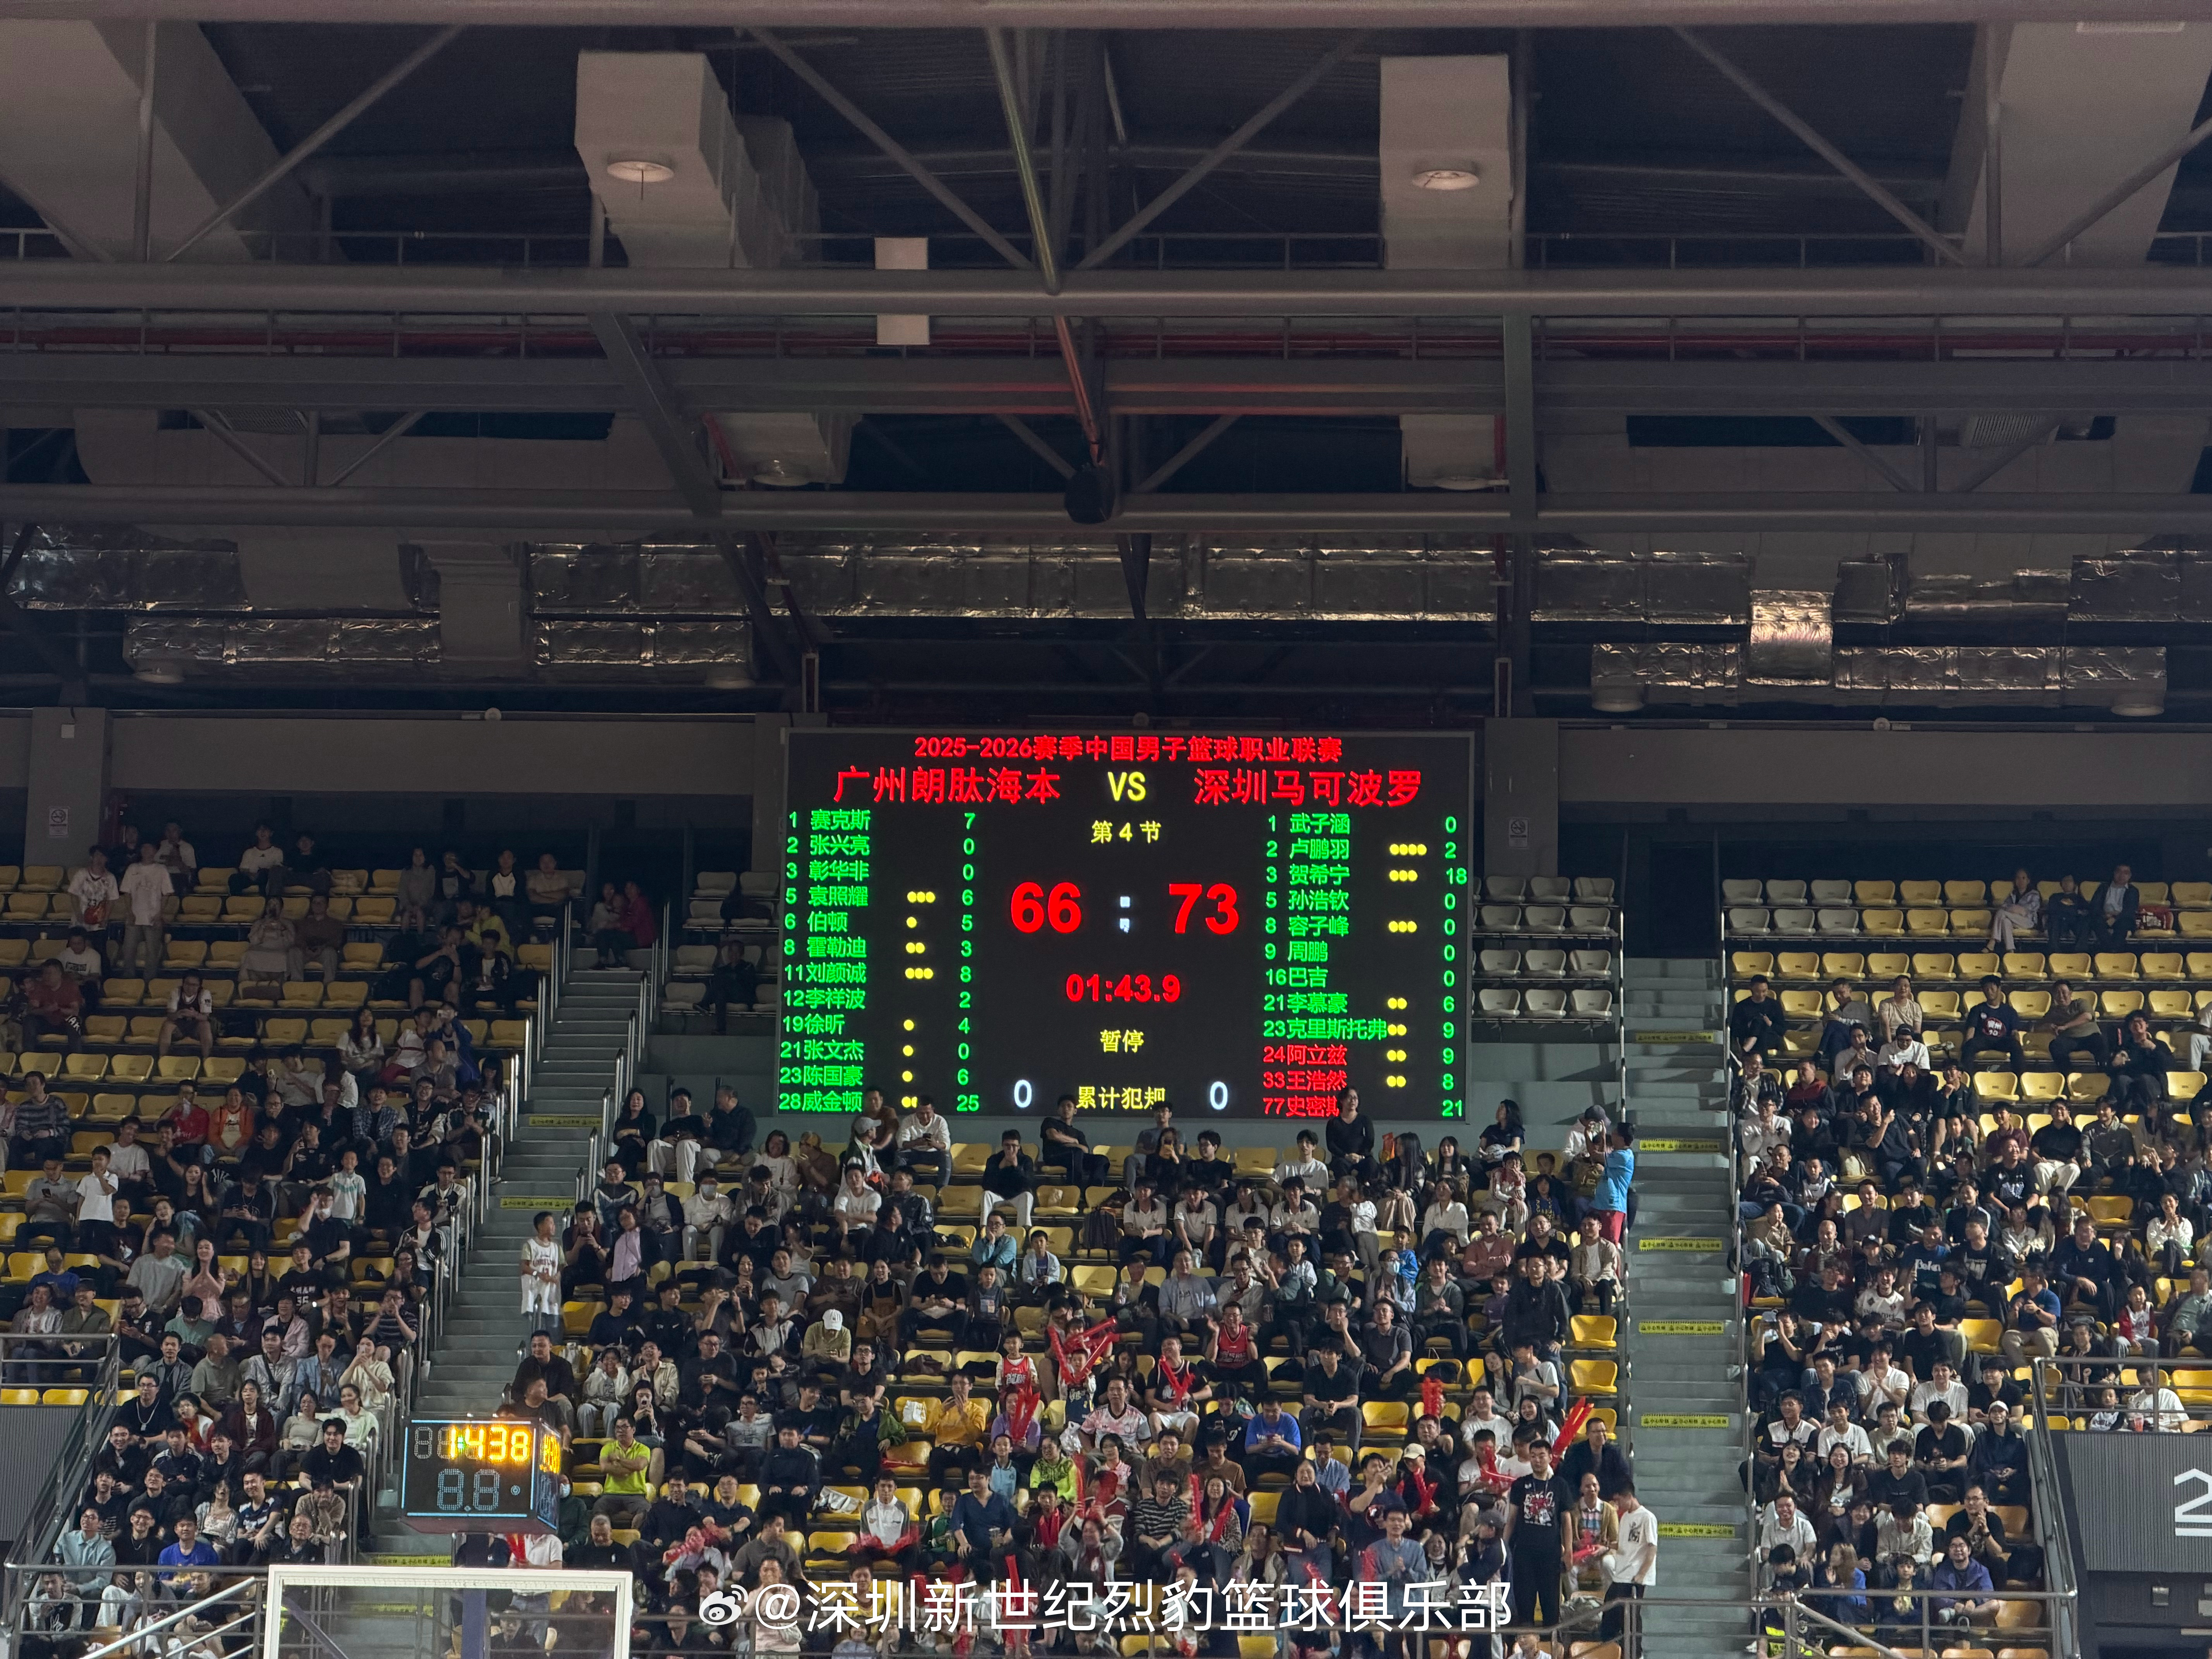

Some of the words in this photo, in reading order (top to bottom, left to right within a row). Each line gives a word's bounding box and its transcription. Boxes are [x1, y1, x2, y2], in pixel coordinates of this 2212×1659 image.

[915, 735, 1342, 763] 2025-2026赛季中国男子篮球职业联赛
[833, 765, 1060, 805] 广州朗肽海本
[1108, 772, 1146, 801] VS
[1194, 768, 1421, 807] 深圳马可波罗
[789, 812, 797, 828] 1
[811, 809, 871, 831] 赛克斯
[965, 813, 975, 829] 7
[1269, 815, 1275, 831] 1
[1445, 816, 1456, 833] 0
[787, 836, 798, 853] 2
[810, 834, 870, 855] 张兴亮
[963, 838, 975, 855] 0
[1266, 840, 1278, 857] 2
[1290, 838, 1349, 860] 卢鹏羽
[1445, 842, 1456, 859] 2
[787, 862, 797, 879] 3
[963, 864, 974, 881] 0
[1266, 866, 1277, 883] 3
[1289, 864, 1350, 885] 贺希宁
[1446, 867, 1467, 884] 18
[786, 888, 797, 904] 5
[808, 885, 868, 907] 袁照耀
[962, 889, 973, 905] 6
[1266, 891, 1277, 908] 5
[1288, 889, 1349, 911] 孙浩钦
[1444, 893, 1455, 910] 0
[1011, 882, 1081, 933] 66
[1169, 883, 1239, 935] 73
[785, 913, 796, 929] 6
[807, 911, 848, 932] 伯顿
[962, 915, 973, 931] 5
[1265, 917, 1276, 934] 8
[1288, 915, 1349, 937] 容子峰
[1444, 919, 1455, 936] 0
[784, 939, 795, 955] 8
[807, 936, 867, 958] 霍勒迪
[961, 940, 972, 957] 3
[1265, 943, 1276, 960] 9
[1288, 941, 1328, 962] 周鹏
[1444, 944, 1455, 961] 0
[960, 966, 971, 982] 8
[1443, 970, 1455, 987] 0
[1066, 974, 1180, 1002] 01:43.9
[959, 991, 970, 1008] 2
[1443, 996, 1455, 1012] 6
[958, 1018, 970, 1034] 4
[1443, 1022, 1454, 1039] 9
[958, 1043, 969, 1060] 0
[1100, 1029, 1144, 1053] 暂停
[1443, 1047, 1454, 1065] 9
[958, 1068, 969, 1085] 6
[1442, 1073, 1454, 1090] 8
[957, 1094, 979, 1111] 25
[1014, 1079, 1032, 1108] 0
[1209, 1081, 1228, 1110] 0
[1442, 1099, 1462, 1116] 21
